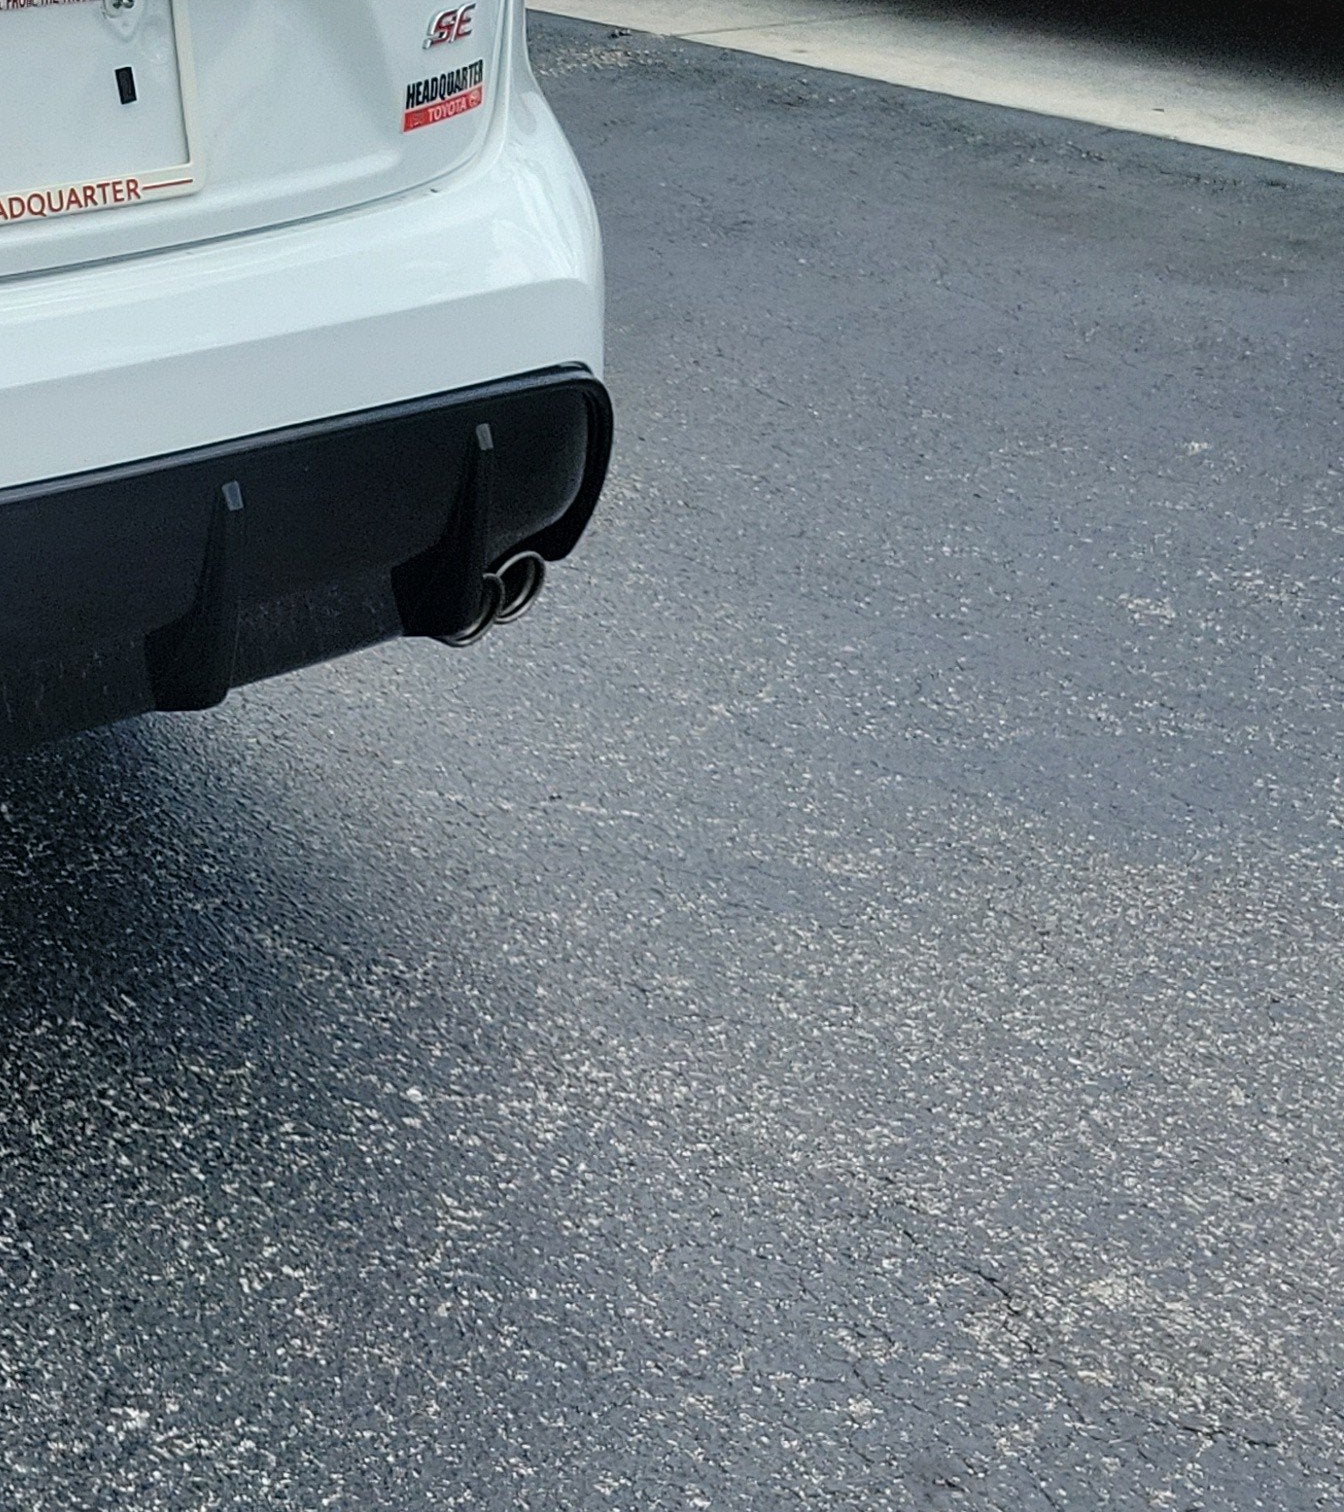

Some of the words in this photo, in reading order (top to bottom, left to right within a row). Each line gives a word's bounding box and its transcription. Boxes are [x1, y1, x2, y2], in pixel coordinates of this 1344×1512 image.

[422, 2, 476, 49] SE
[405, 59, 483, 110] HEADQUARTER
[428, 96, 467, 123] TOYOTA
